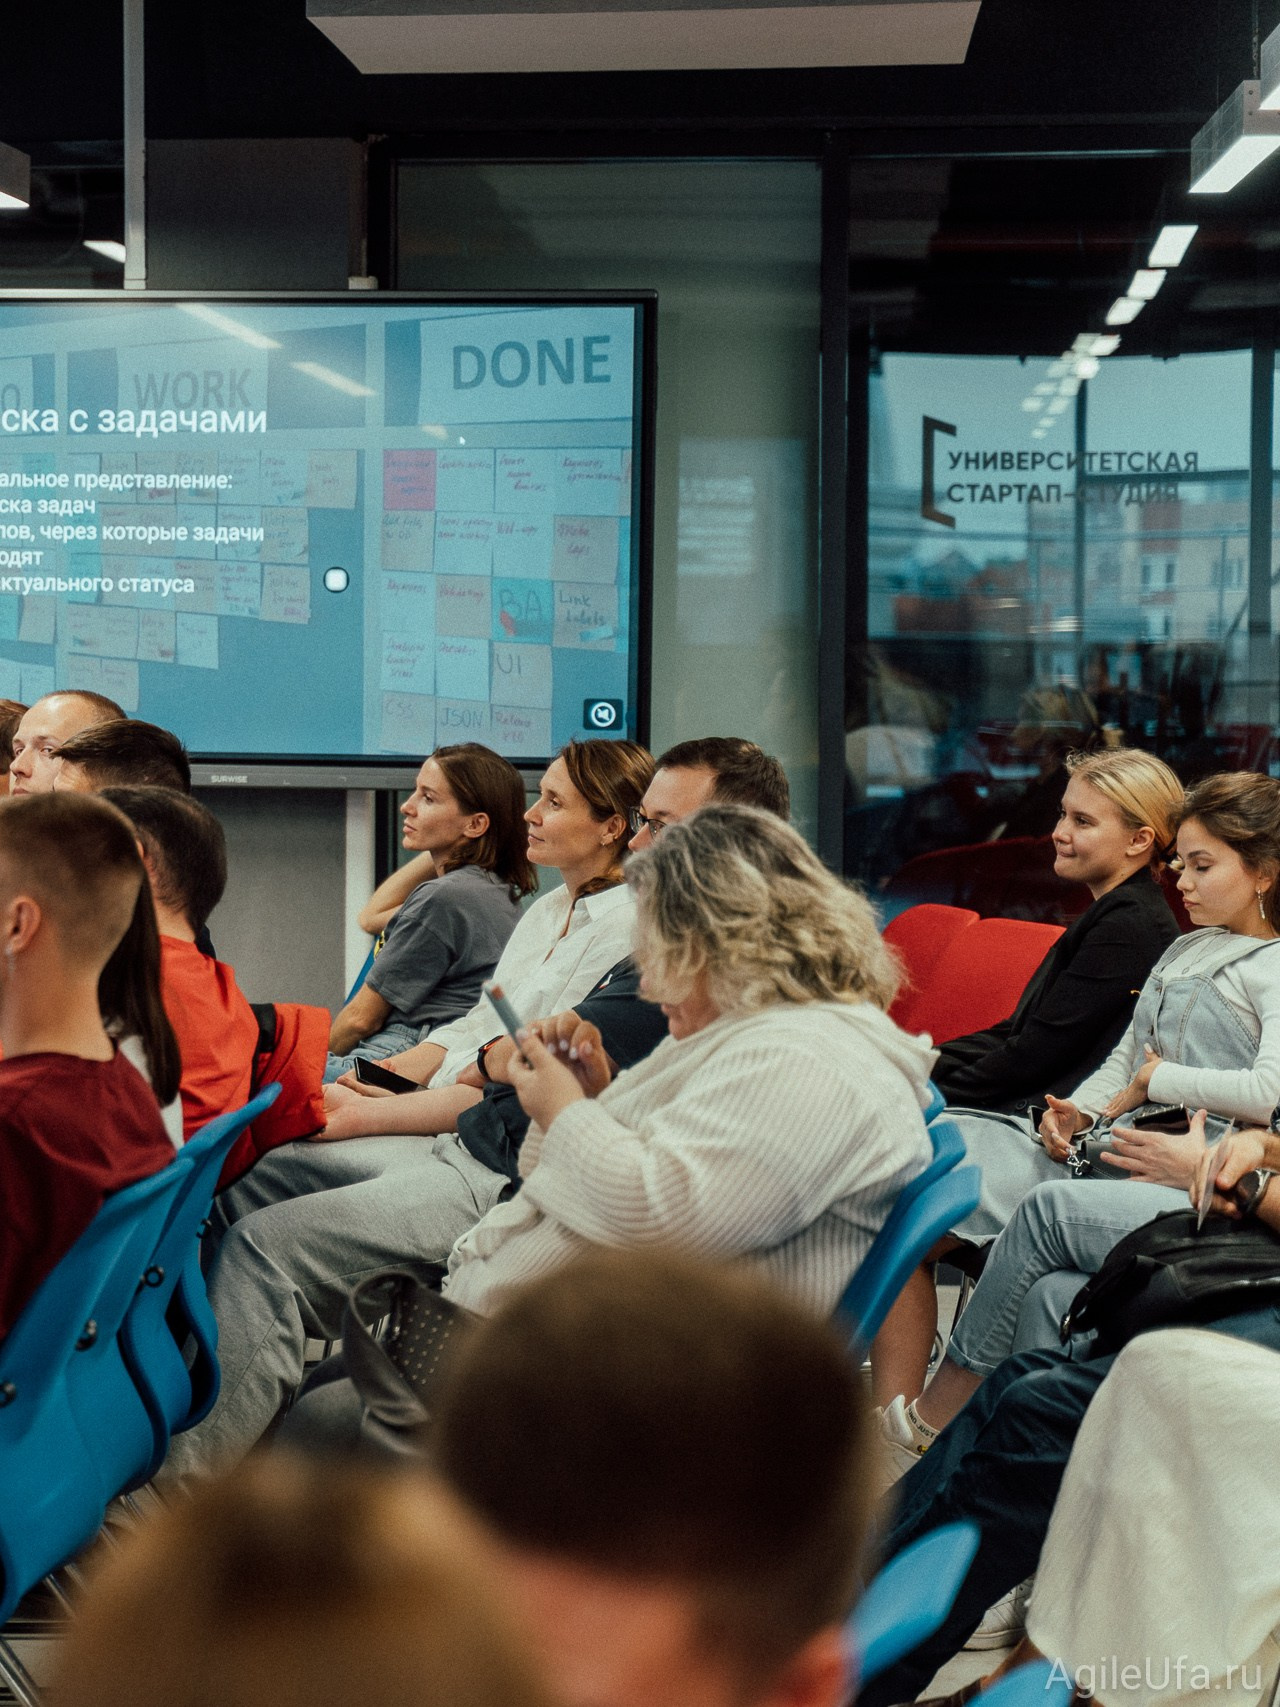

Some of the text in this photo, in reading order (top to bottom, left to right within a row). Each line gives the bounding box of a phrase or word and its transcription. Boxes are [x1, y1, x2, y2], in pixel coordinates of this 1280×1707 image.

[452, 334, 612, 390] DONE
[133, 367, 252, 410] WORK
[70, 410, 89, 433] с
[98, 410, 268, 438] задачами
[948, 451, 1199, 473] УНИВЕРСИТЕТСКАЯ
[75, 474, 233, 492] представление:
[38, 500, 96, 518] задач
[40, 526, 98, 544] через
[103, 527, 189, 545] которые
[193, 528, 265, 545] задачи
[119, 579, 195, 597] статуса
[440, 707, 483, 728] JSON
